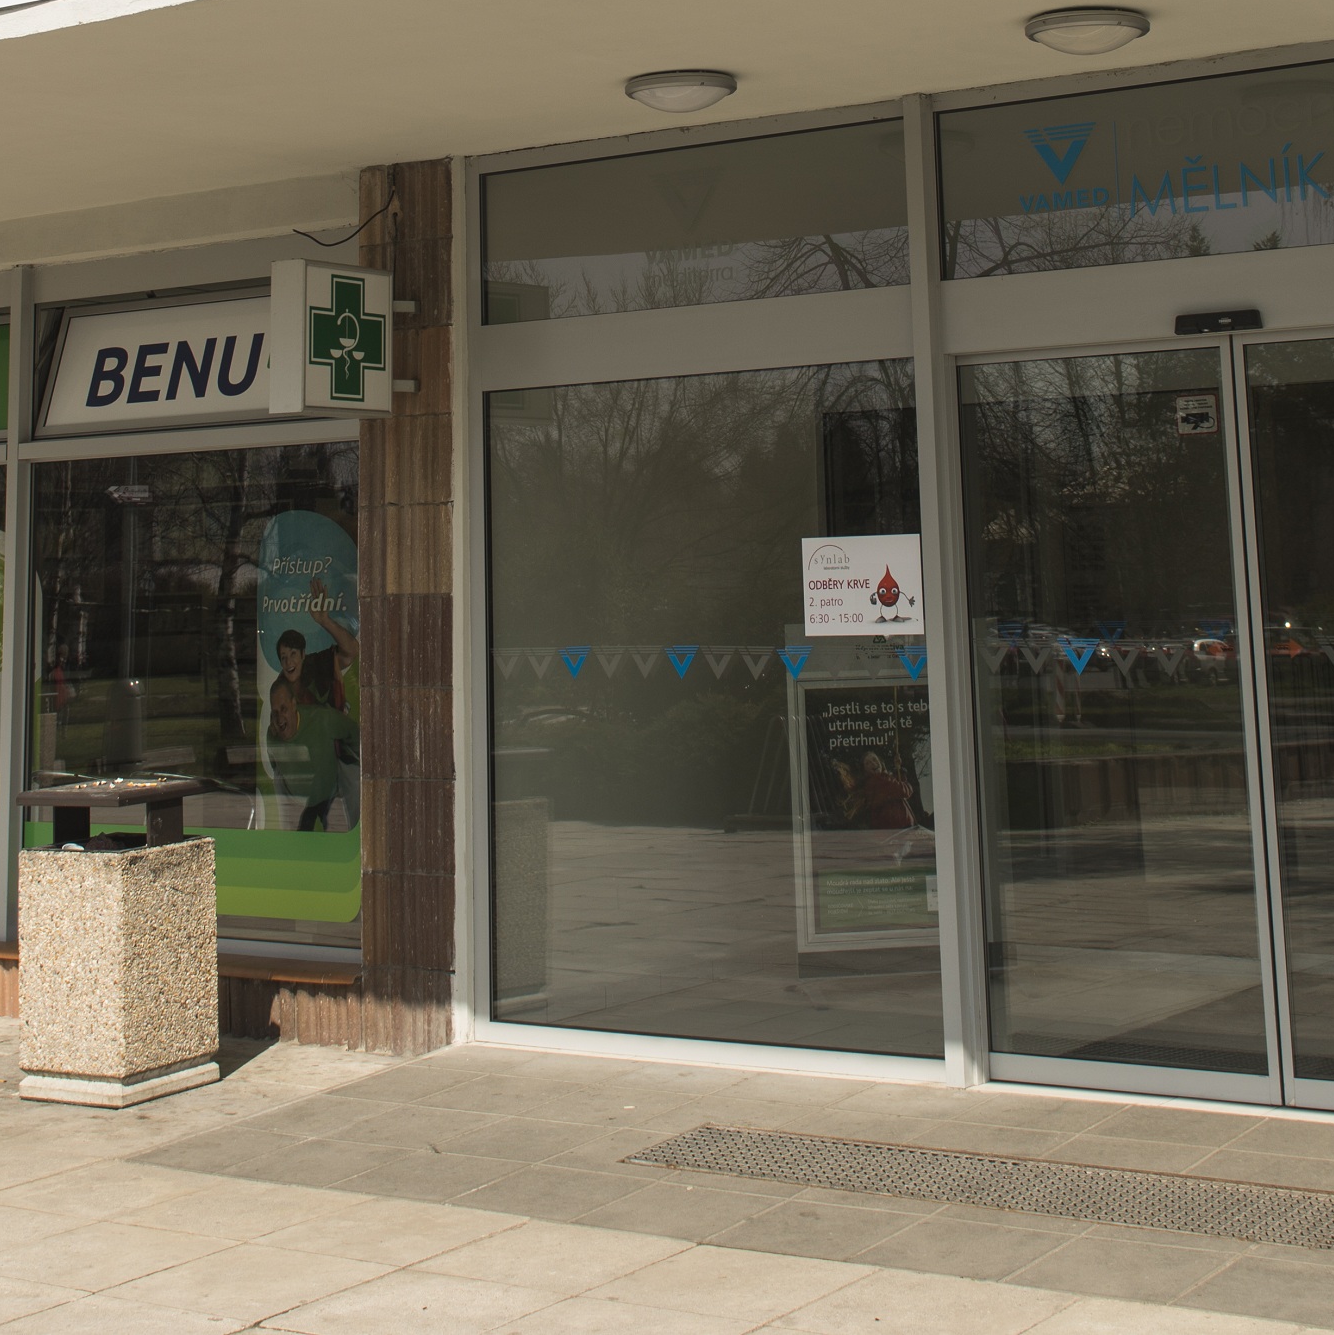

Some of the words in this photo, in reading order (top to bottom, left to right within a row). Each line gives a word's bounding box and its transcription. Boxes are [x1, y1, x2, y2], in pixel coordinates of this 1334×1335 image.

[1130, 141, 1331, 219] MĚLNÍK
[1018, 187, 1110, 214] VAMED
[84, 331, 265, 409] BENU
[272, 556, 333, 578] Přístup?
[813, 553, 850, 565] synlab
[808, 578, 845, 591] ODBĚRY
[847, 578, 871, 590] KRVE
[262, 592, 347, 613] Prvotřídní.
[809, 597, 818, 607] 2.
[820, 597, 844, 609] patro
[809, 613, 830, 624] 6:30
[838, 613, 864, 624] 15:00
[864, 703, 878, 714] se
[880, 702, 894, 713] to
[898, 703, 904, 712] s
[907, 699, 929, 712] teb
[828, 718, 874, 732] utrhne,
[877, 716, 896, 729] tak
[900, 715, 913, 728] tě
